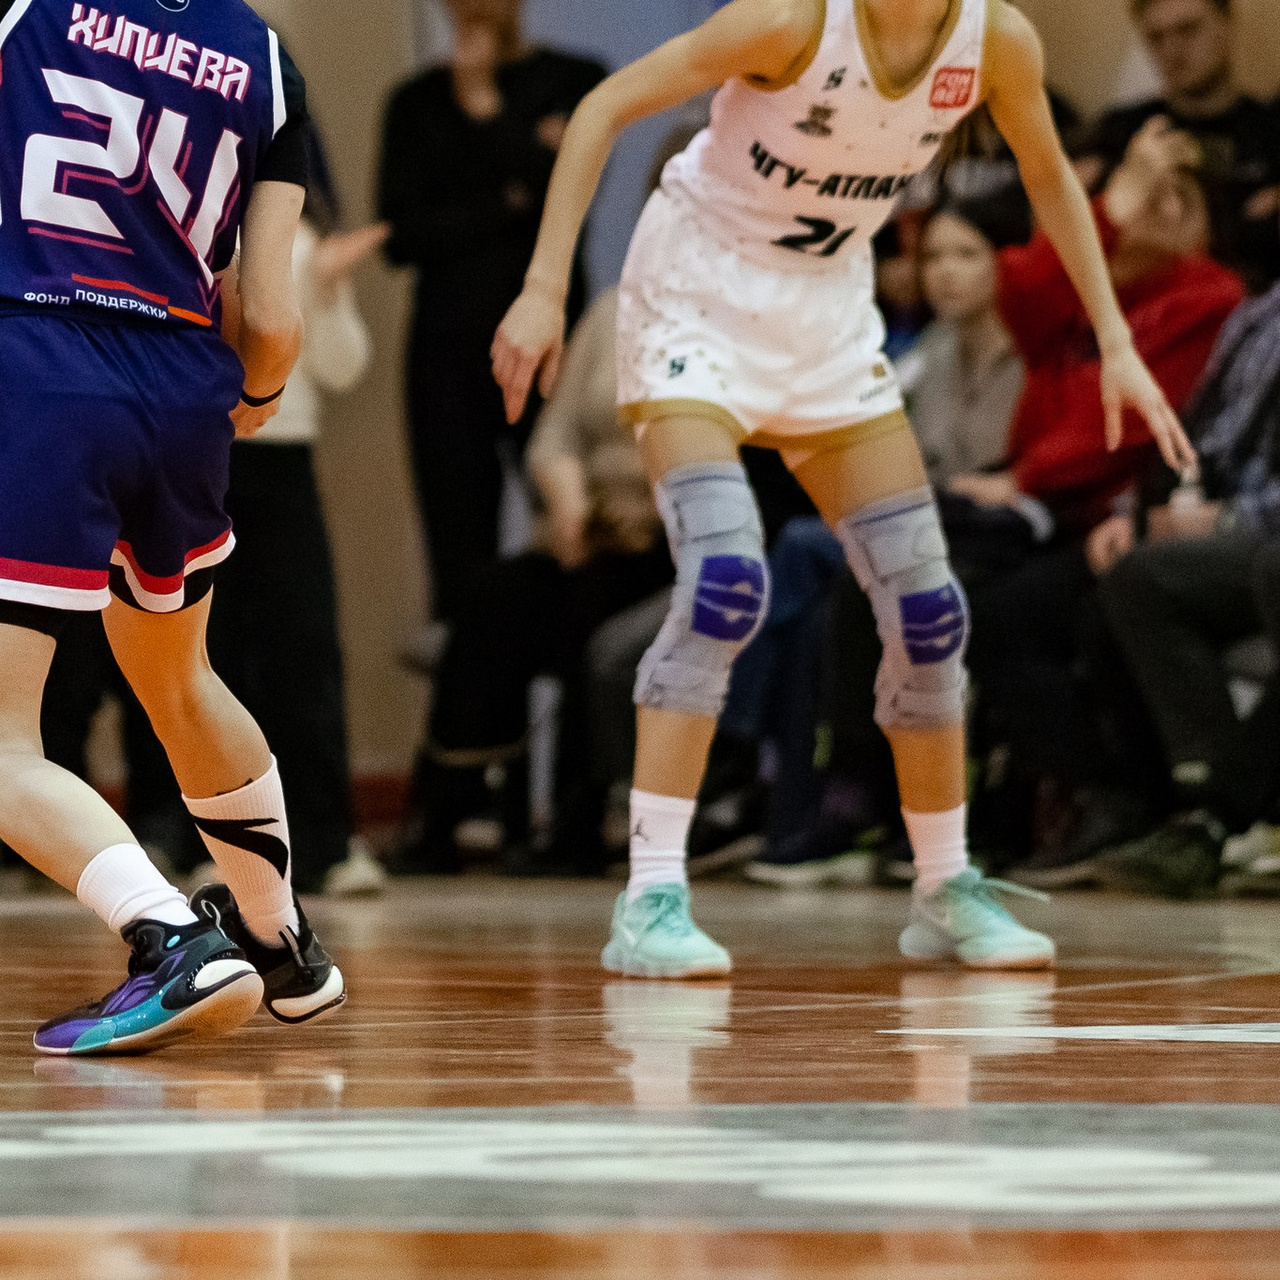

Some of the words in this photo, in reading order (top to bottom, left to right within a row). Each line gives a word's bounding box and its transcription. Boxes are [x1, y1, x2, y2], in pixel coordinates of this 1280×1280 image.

[20, 67, 244, 291] 24
[770, 214, 857, 258] 21
[75, 288, 168, 320] ПОДДЕРЖКИ
